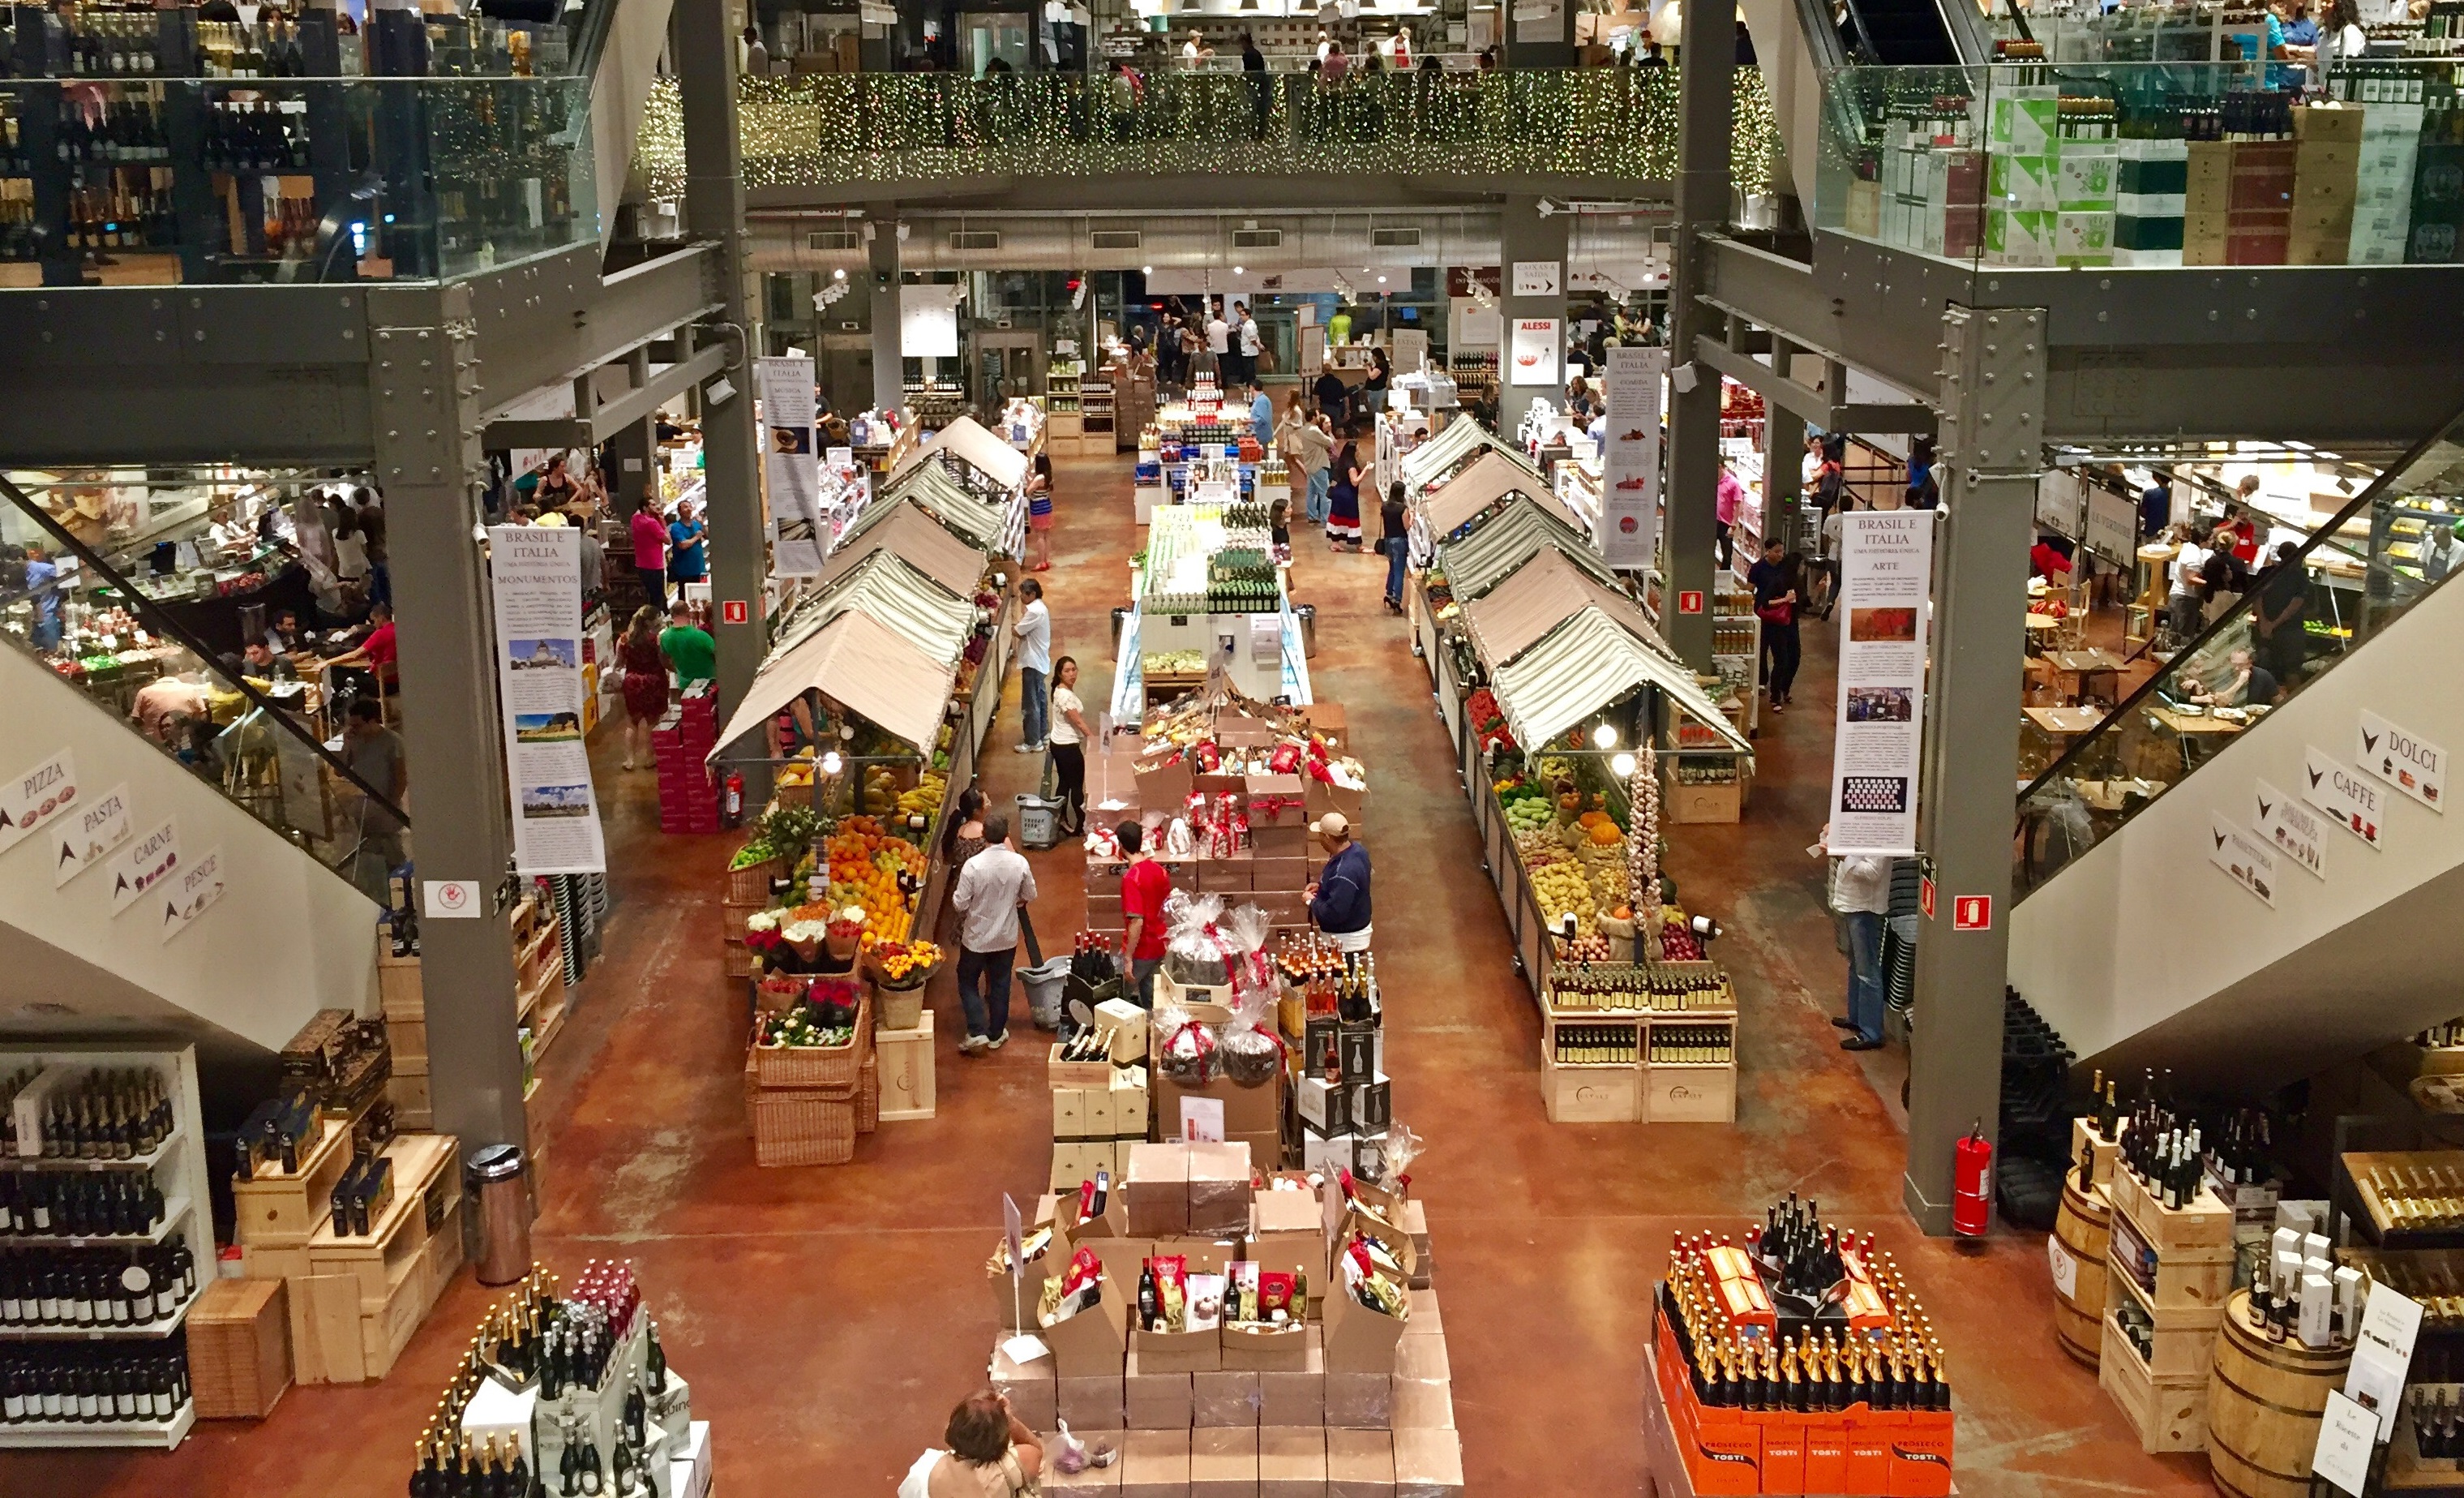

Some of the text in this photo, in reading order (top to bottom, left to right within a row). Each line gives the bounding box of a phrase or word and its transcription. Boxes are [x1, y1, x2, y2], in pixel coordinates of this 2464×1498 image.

[1521, 321, 1551, 330] ALESSI
[1858, 519, 1918, 530] BRASIL E
[505, 531, 565, 543] BRASIL E
[1865, 534, 1909, 545] ITALIA
[513, 547, 559, 558] ITALIA
[1871, 562, 1900, 570] ARTE
[498, 575, 578, 585] MONUMENTOS
[2389, 730, 2437, 774] DOLCI
[24, 761, 66, 800] PIZZA
[84, 795, 123, 833] PASTA
[134, 824, 173, 865] CARNE
[184, 854, 217, 893] PESCE
[1705, 1441, 1752, 1449] PROSECCO
[1897, 1440, 1945, 1449] PROSECCO
